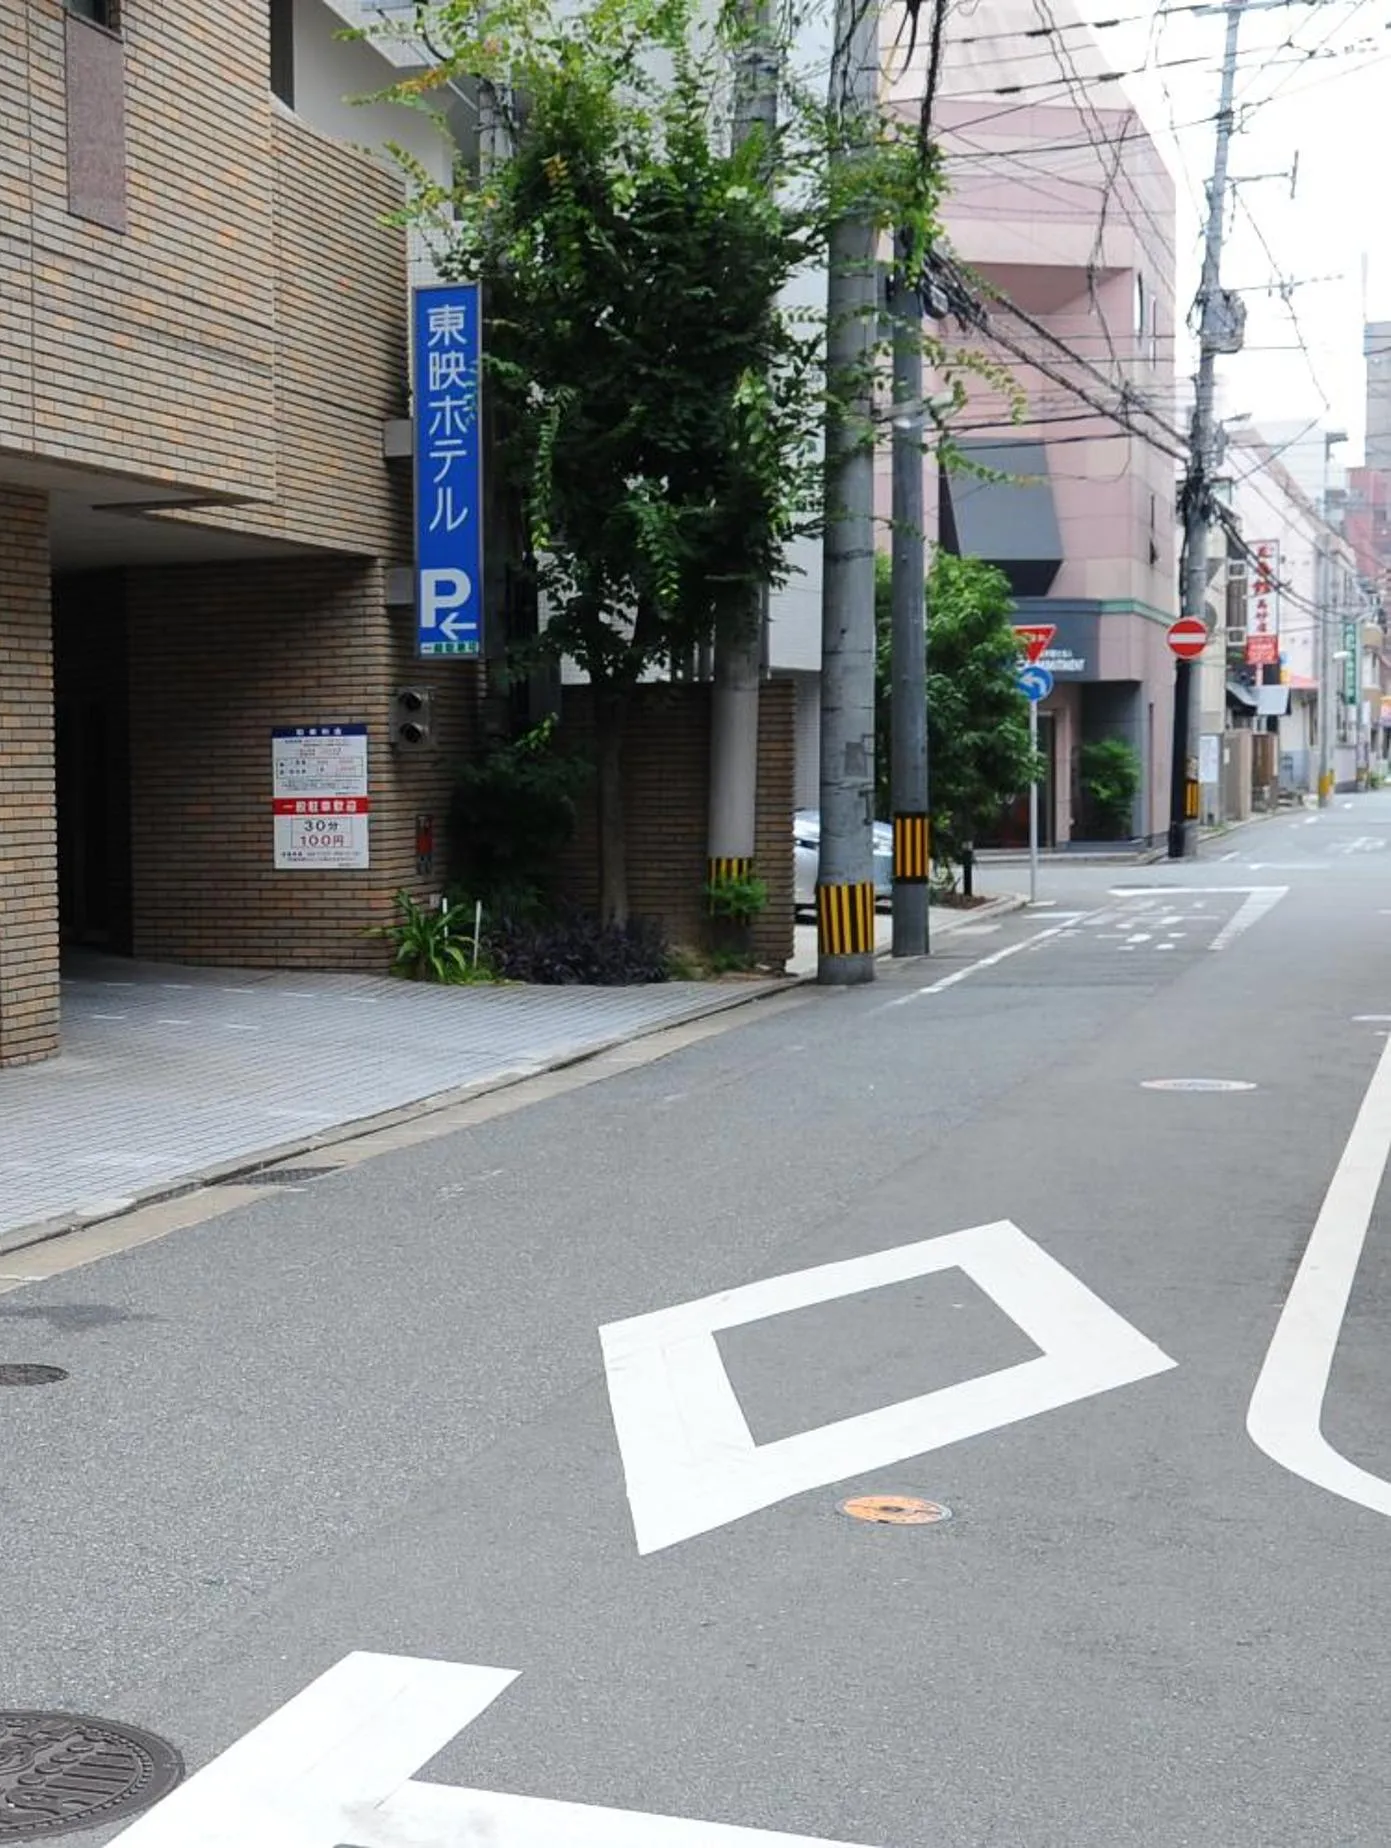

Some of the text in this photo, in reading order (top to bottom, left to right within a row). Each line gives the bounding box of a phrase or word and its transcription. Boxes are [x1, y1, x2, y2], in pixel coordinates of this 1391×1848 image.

[426, 303, 469, 532] 東映ホテル
[420, 567, 472, 628] P
[300, 834, 344, 847] 100円
[304, 819, 339, 832] 30分
